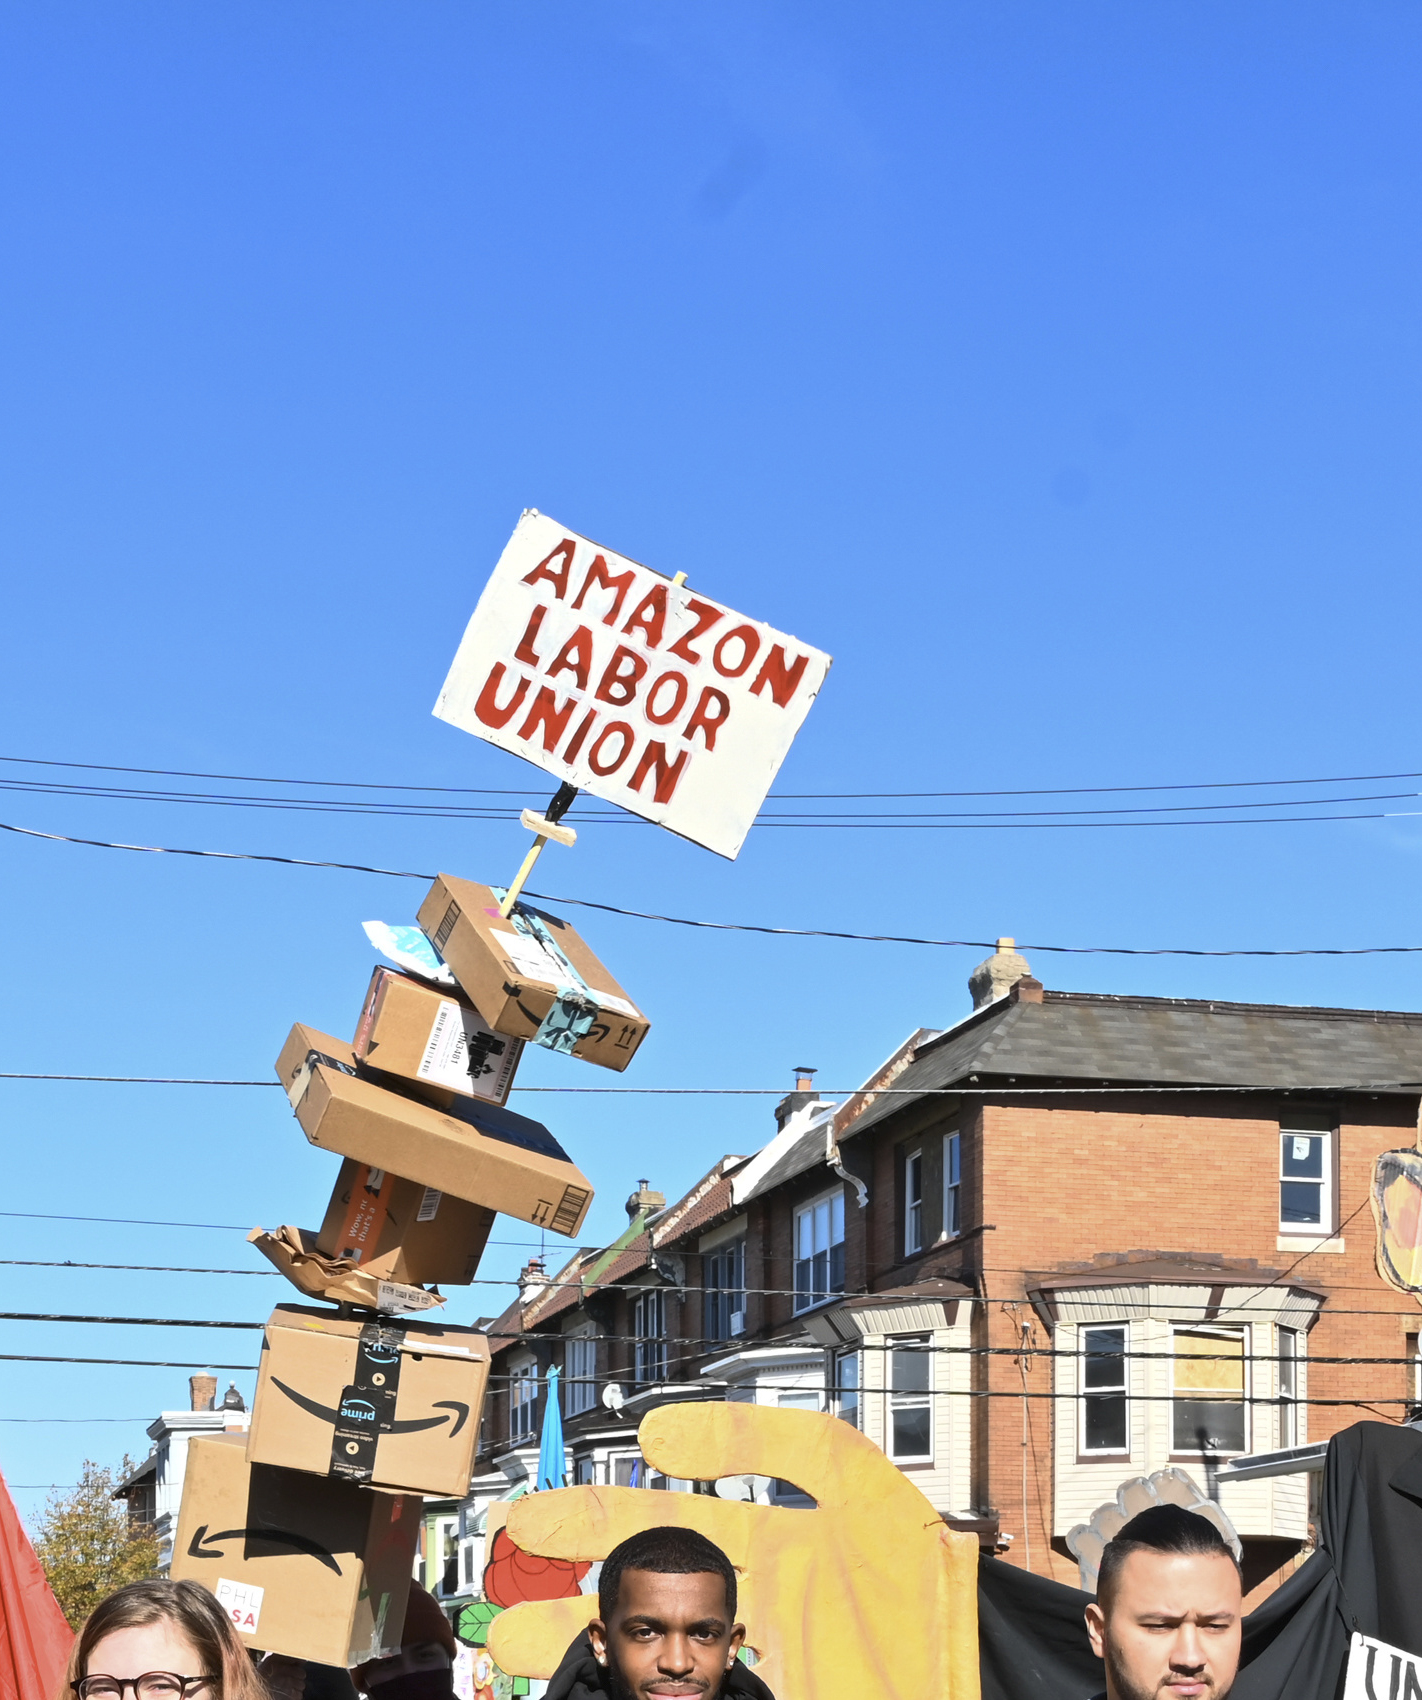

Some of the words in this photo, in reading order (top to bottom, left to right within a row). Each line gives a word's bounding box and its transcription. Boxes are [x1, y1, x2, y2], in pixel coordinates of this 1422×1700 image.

[521, 538, 809, 709] AMAZON
[514, 605, 731, 752] LABOR
[474, 661, 690, 805] UNION
[450, 1031, 469, 1065] UN3481
[348, 1213, 365, 1238] Wow,
[358, 1215, 374, 1242] that's
[340, 1408, 376, 1422] prime
[219, 1584, 259, 1609] PHL
[225, 1608, 256, 1628] SA
